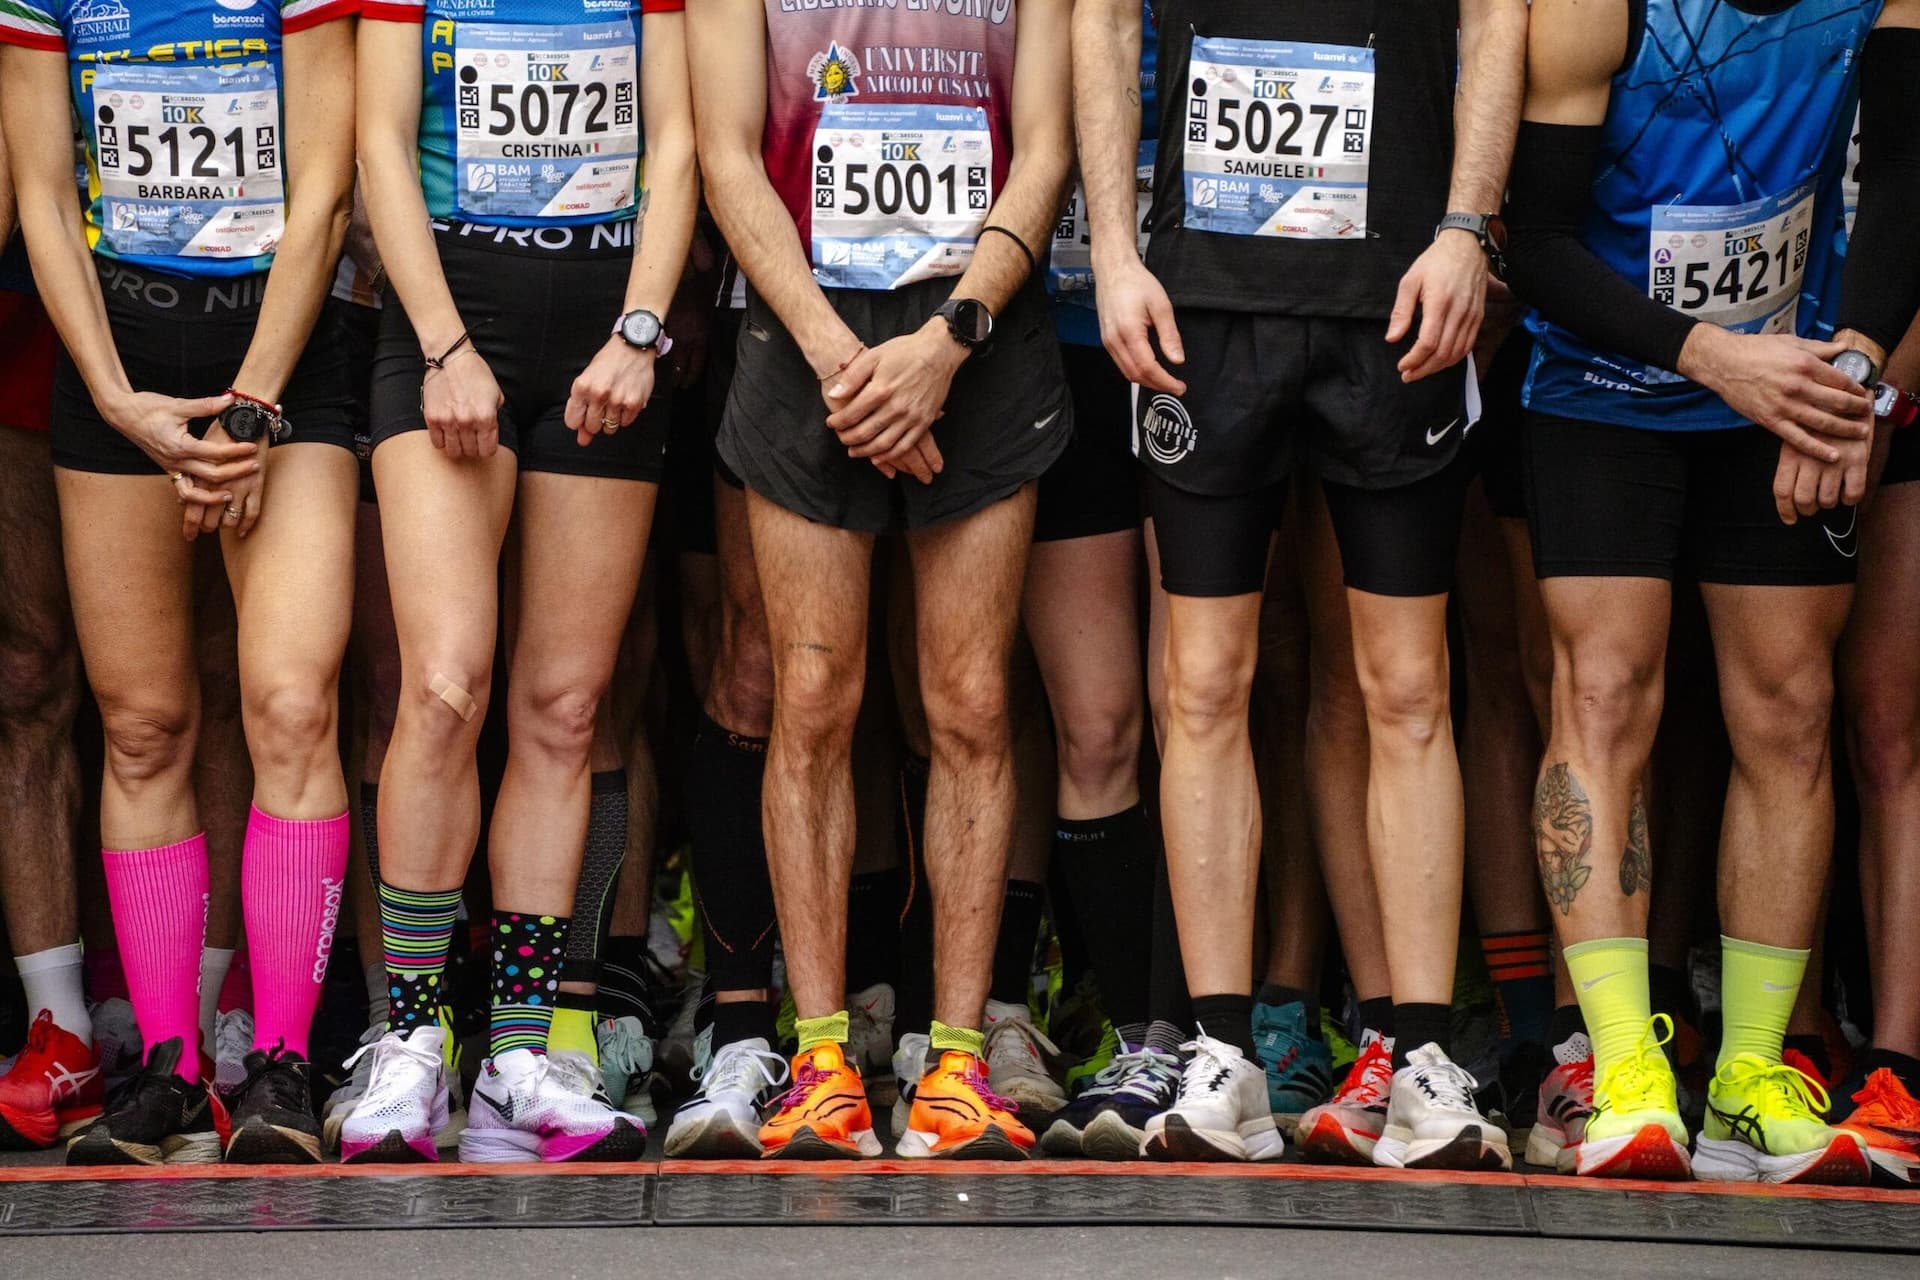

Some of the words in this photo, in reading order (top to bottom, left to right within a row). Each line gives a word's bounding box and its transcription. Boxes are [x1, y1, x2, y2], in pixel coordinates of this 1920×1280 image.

[73, 19, 130, 37] GENERALI
[583, 31, 613, 41] luanvi
[865, 46, 988, 77] UNIVERSIT
[1313, 51, 1346, 63] luanvi
[529, 64, 564, 81] 10K
[1254, 80, 1291, 99] 10K
[163, 106, 201, 123] 10K
[489, 82, 608, 136] 5072
[936, 112, 964, 122] luanvi
[1215, 98, 1339, 157] 5027
[128, 125, 245, 177] 5121
[502, 143, 583, 158] CRISTINA
[882, 143, 918, 160] 10K
[498, 164, 530, 176] BAM
[1223, 159, 1305, 178] SAMUELE
[138, 185, 225, 200] BARBARA
[843, 163, 956, 215] 5001
[1219, 180, 1249, 193] BAM
[138, 205, 169, 217] BAM
[1726, 235, 1762, 256] 10K
[1656, 249, 1670, 263] A
[1681, 240, 1789, 310] 5421
[204, 277, 264, 313] NI
